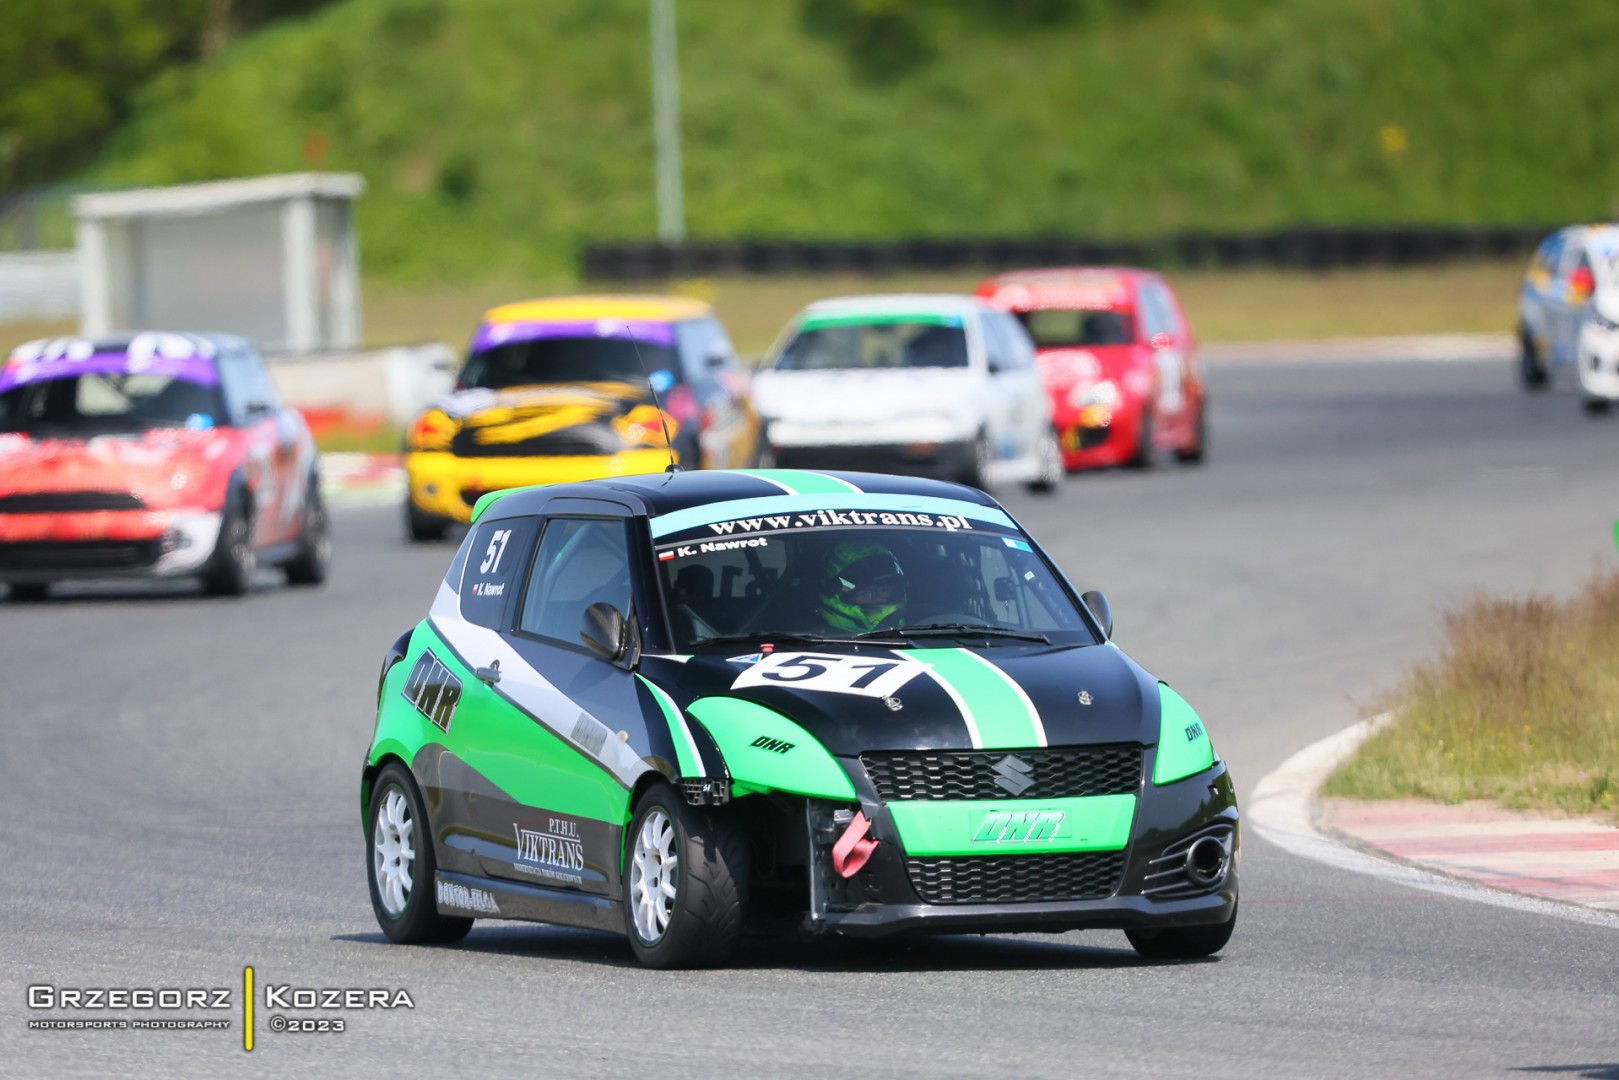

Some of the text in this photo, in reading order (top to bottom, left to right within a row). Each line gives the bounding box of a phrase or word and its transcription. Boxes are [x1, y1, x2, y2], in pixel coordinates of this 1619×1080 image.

[708, 509, 973, 535] www.viktrans.pl
[480, 529, 512, 574] 51
[677, 536, 768, 558] K. Nawrot
[483, 582, 505, 596] Nawrot
[762, 655, 900, 689] 51
[751, 736, 795, 754] DNR
[548, 817, 579, 838] P.T.H.U.
[971, 811, 1065, 843] DNR
[512, 822, 584, 871] VIKTRANS
